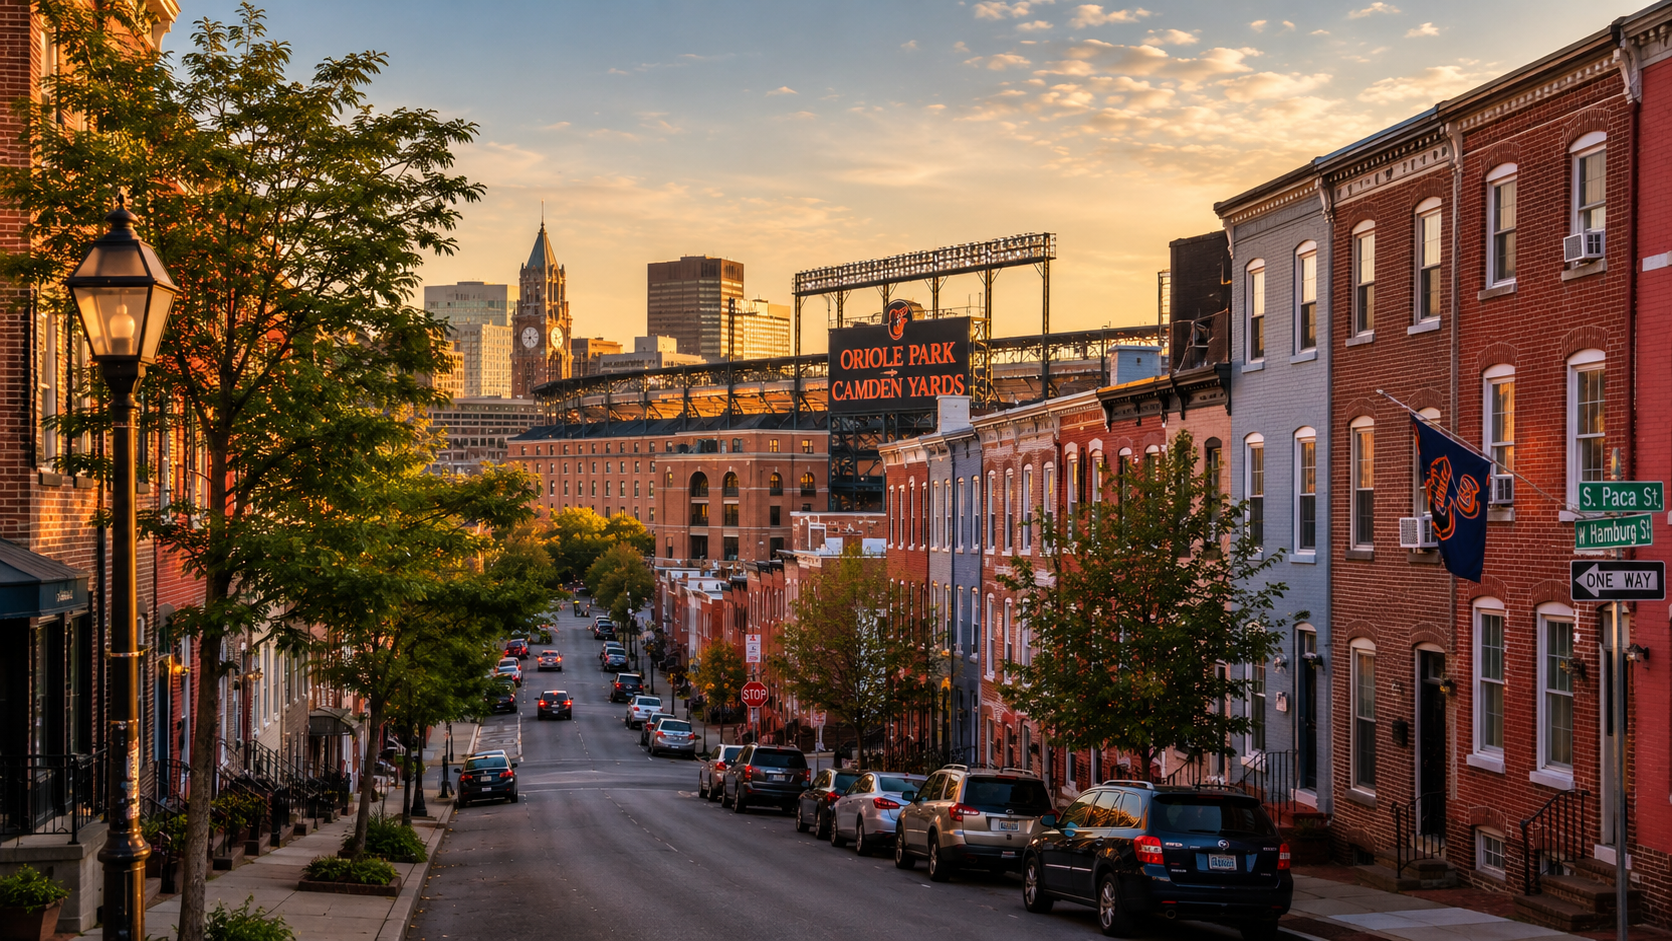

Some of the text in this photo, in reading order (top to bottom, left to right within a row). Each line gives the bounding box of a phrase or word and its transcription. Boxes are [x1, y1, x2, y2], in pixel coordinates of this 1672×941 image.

[840, 342, 956, 370] ORIOLE PARK
[831, 374, 965, 401] CAMDEN YARDS
[1583, 487, 1661, 508] S. Paca St.
[1590, 521, 1636, 545] Hamburg
[1640, 519, 1650, 539] St
[1586, 572, 1652, 588] ONE WAY
[743, 689, 766, 700] STOP
